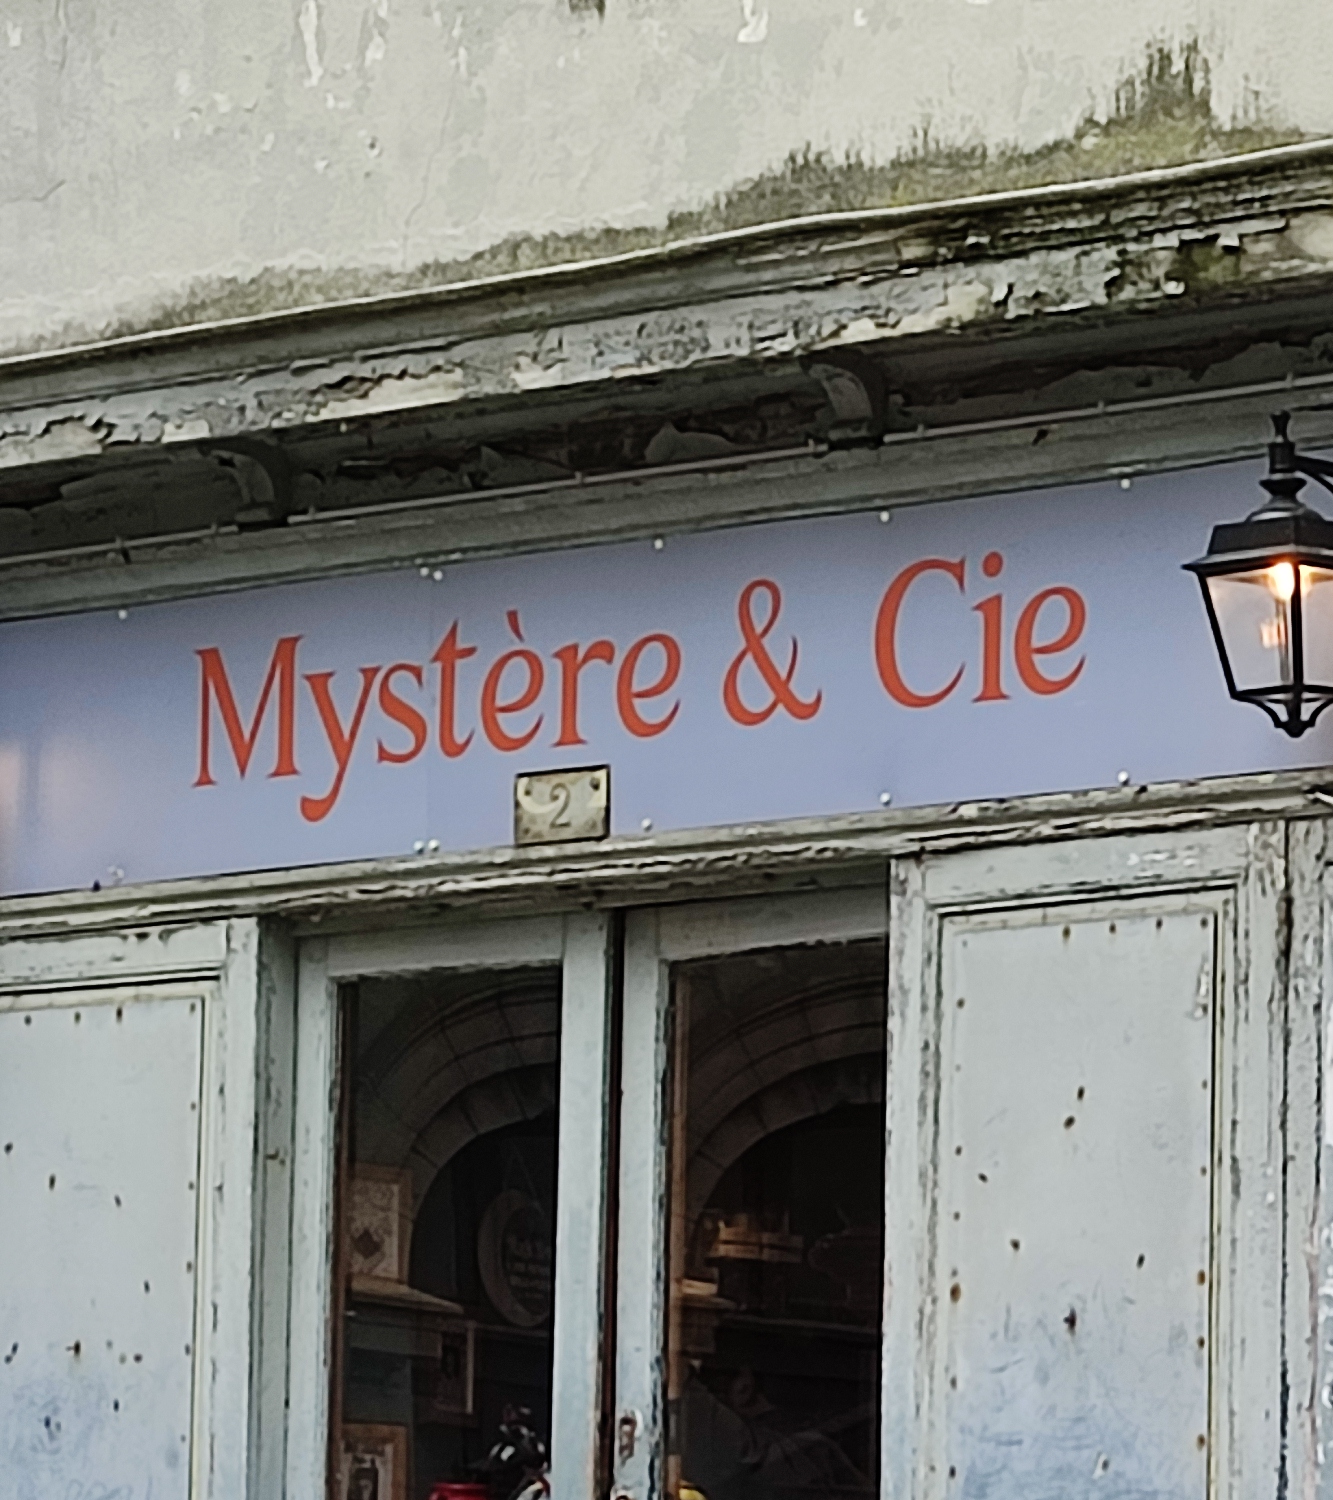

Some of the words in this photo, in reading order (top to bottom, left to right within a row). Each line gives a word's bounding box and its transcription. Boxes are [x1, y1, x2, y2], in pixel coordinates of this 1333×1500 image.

[194, 611, 682, 823] Mystère
[722, 579, 822, 727] &
[874, 551, 1087, 709] Cie
[548, 782, 572, 830] 2
